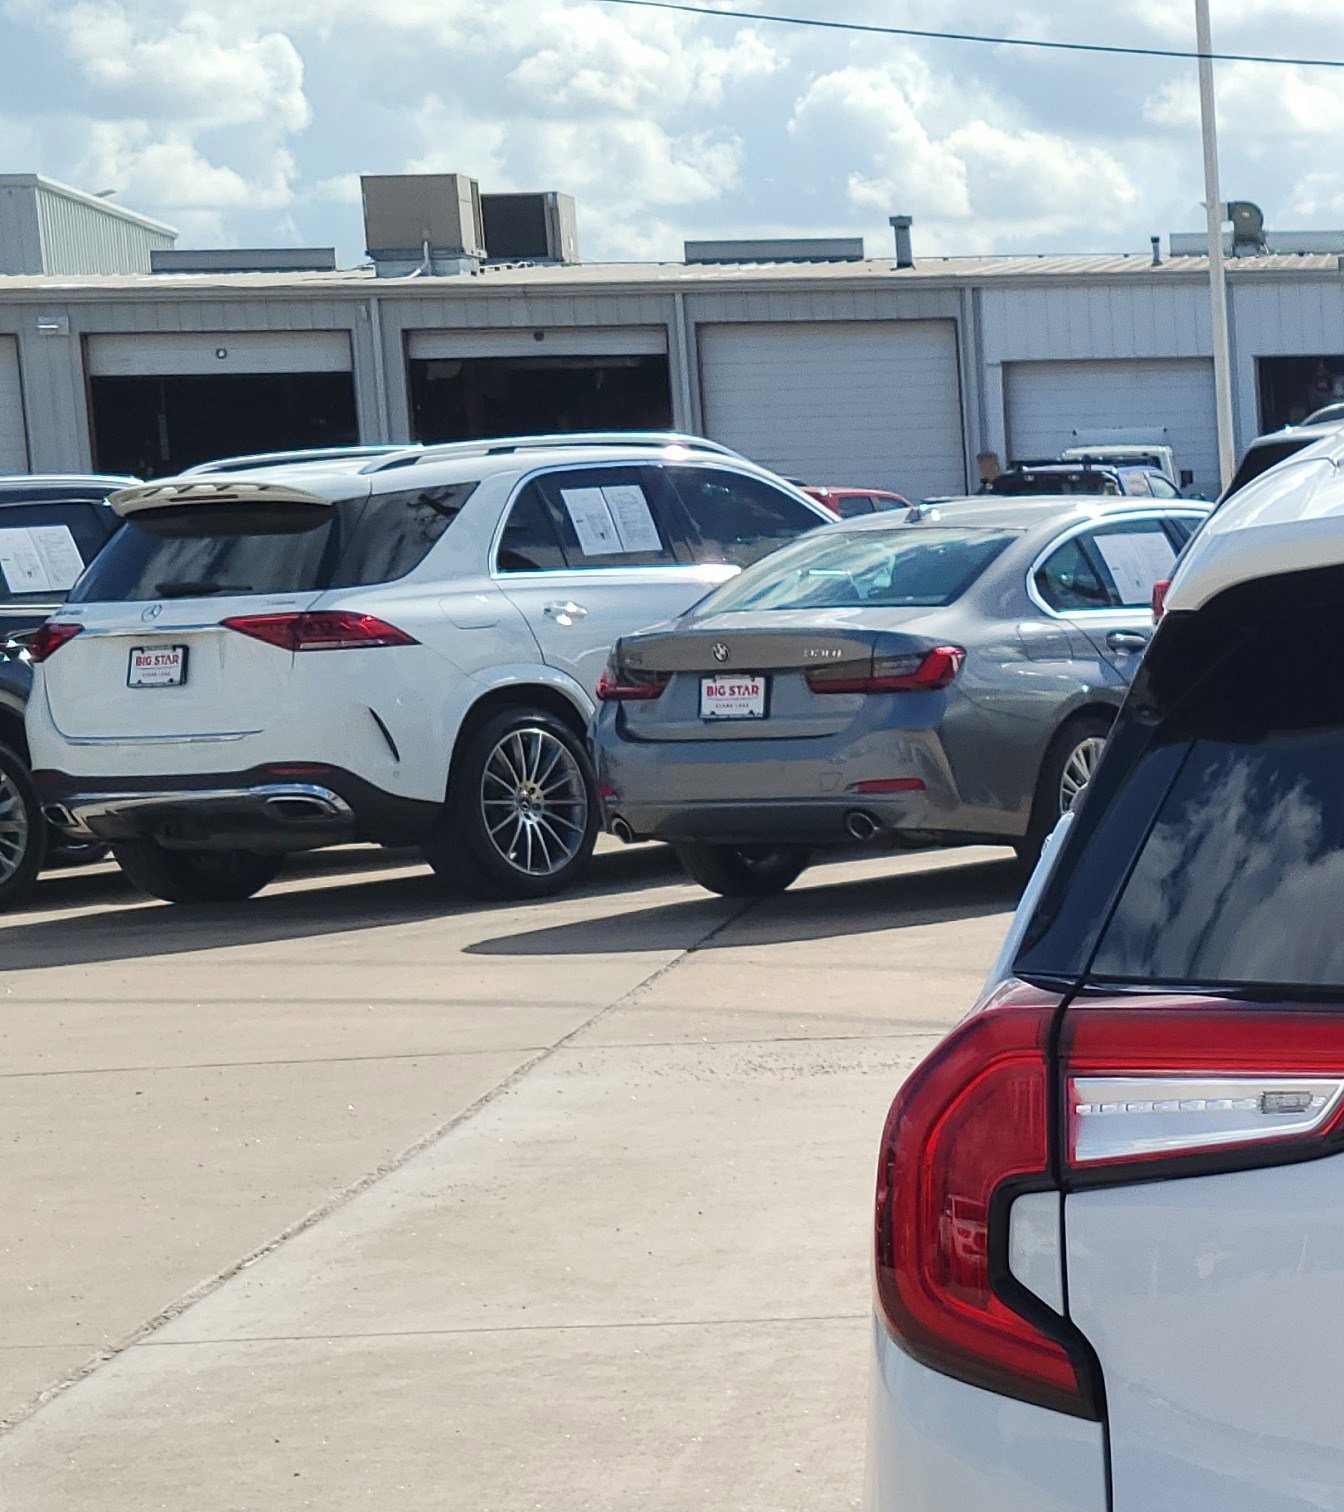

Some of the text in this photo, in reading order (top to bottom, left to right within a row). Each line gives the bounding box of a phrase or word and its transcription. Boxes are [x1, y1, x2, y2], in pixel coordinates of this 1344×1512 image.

[135, 653, 179, 667] BIG STAR
[706, 684, 759, 697] BIG STAR
